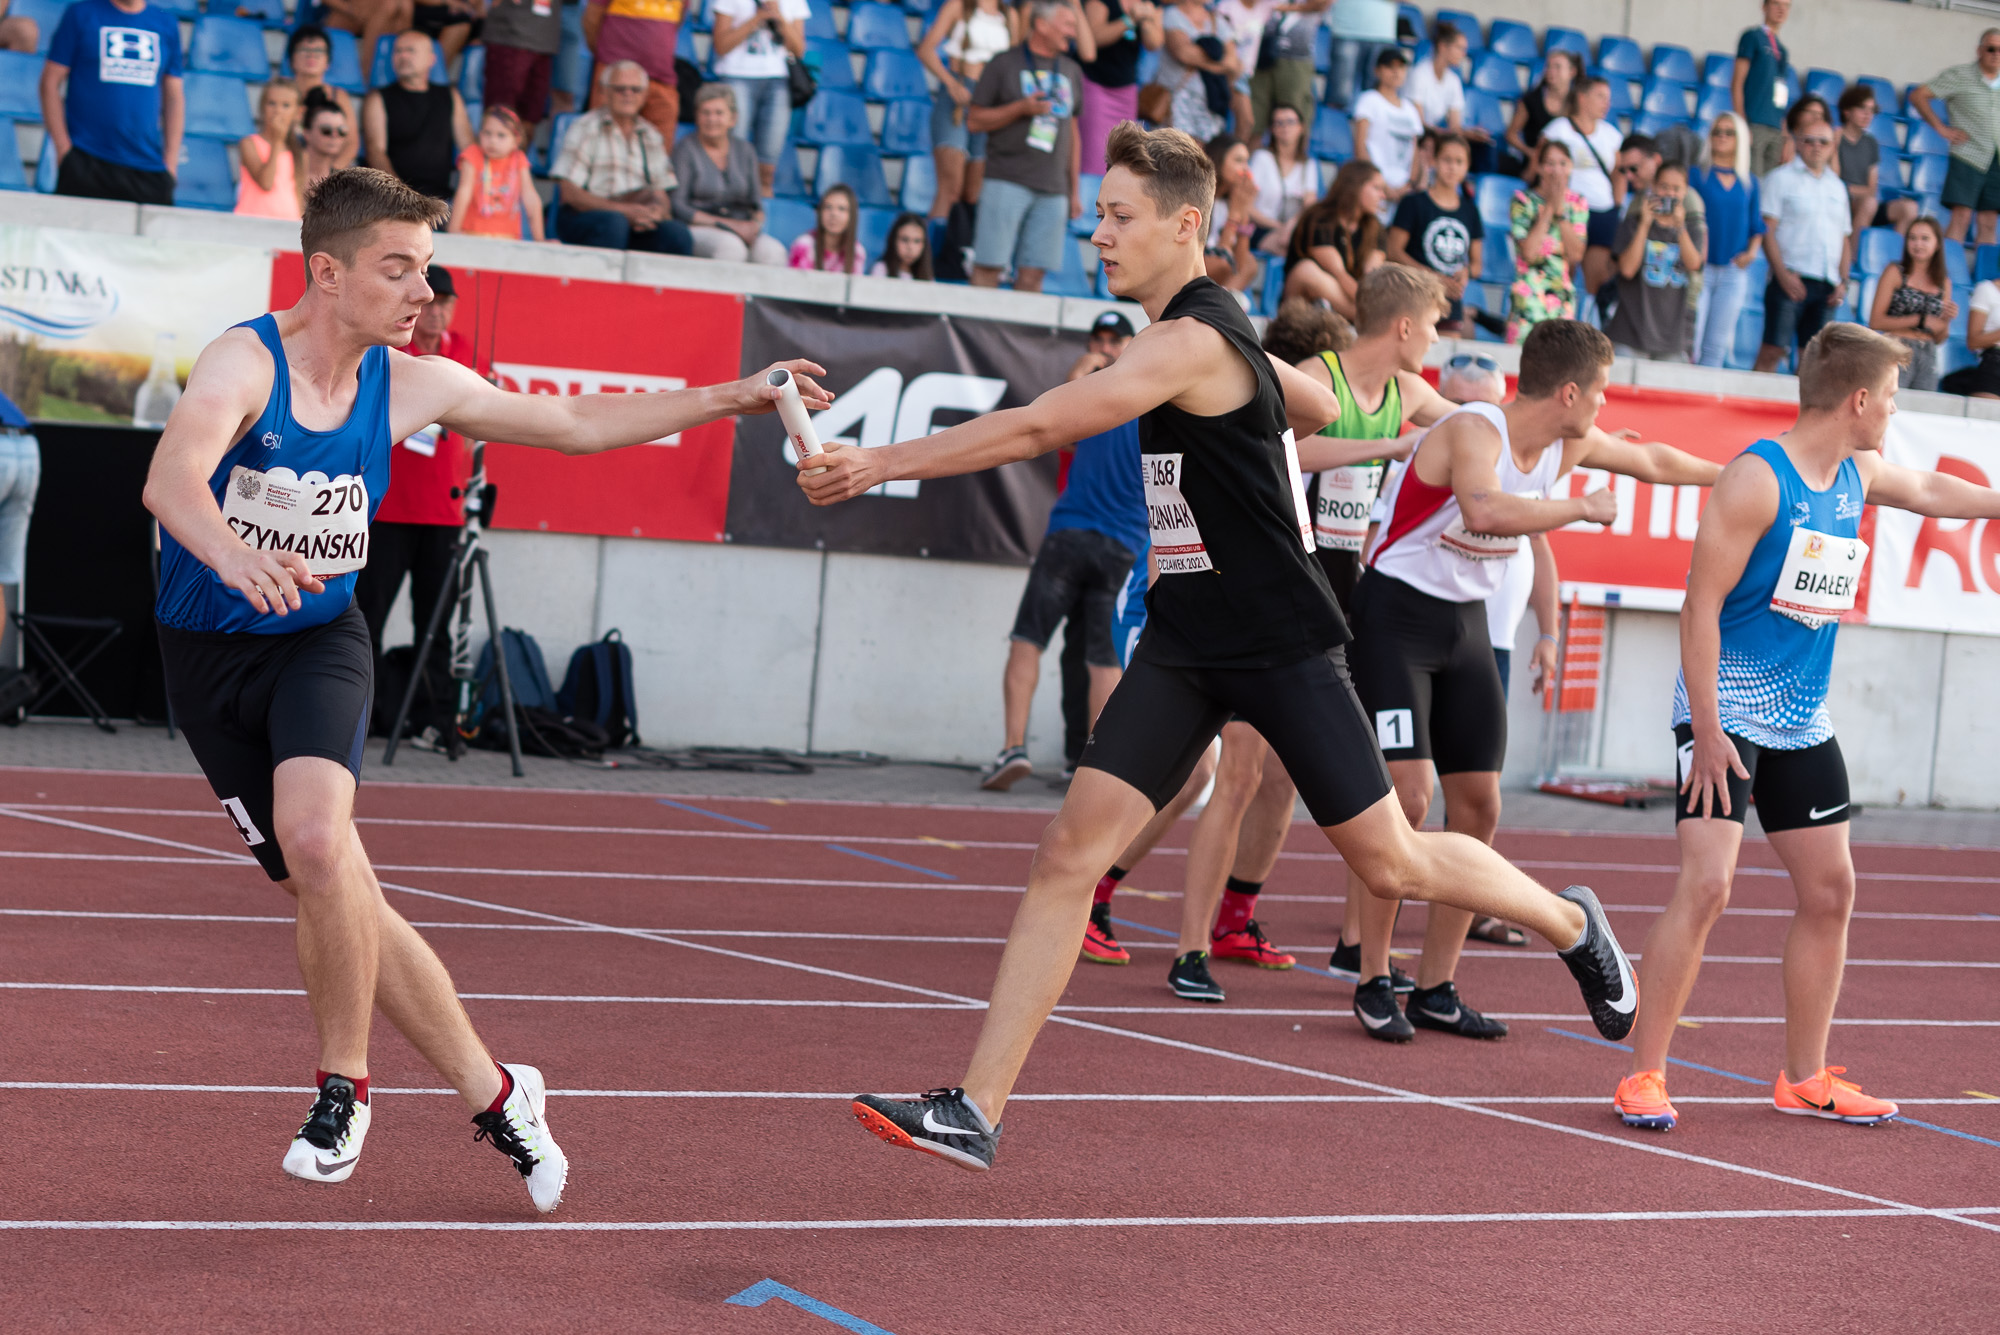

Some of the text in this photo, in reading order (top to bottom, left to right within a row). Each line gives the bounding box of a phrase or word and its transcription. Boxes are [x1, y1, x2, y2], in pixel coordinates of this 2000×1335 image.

[1151, 459, 1175, 486] 268
[267, 487, 292, 498] Kultury
[311, 483, 363, 516] 270
[1187, 556, 1208, 570] 2021
[1847, 542, 1856, 560] 3
[1794, 570, 1854, 597] BIAŁEK
[1386, 713, 1402, 744] 1
